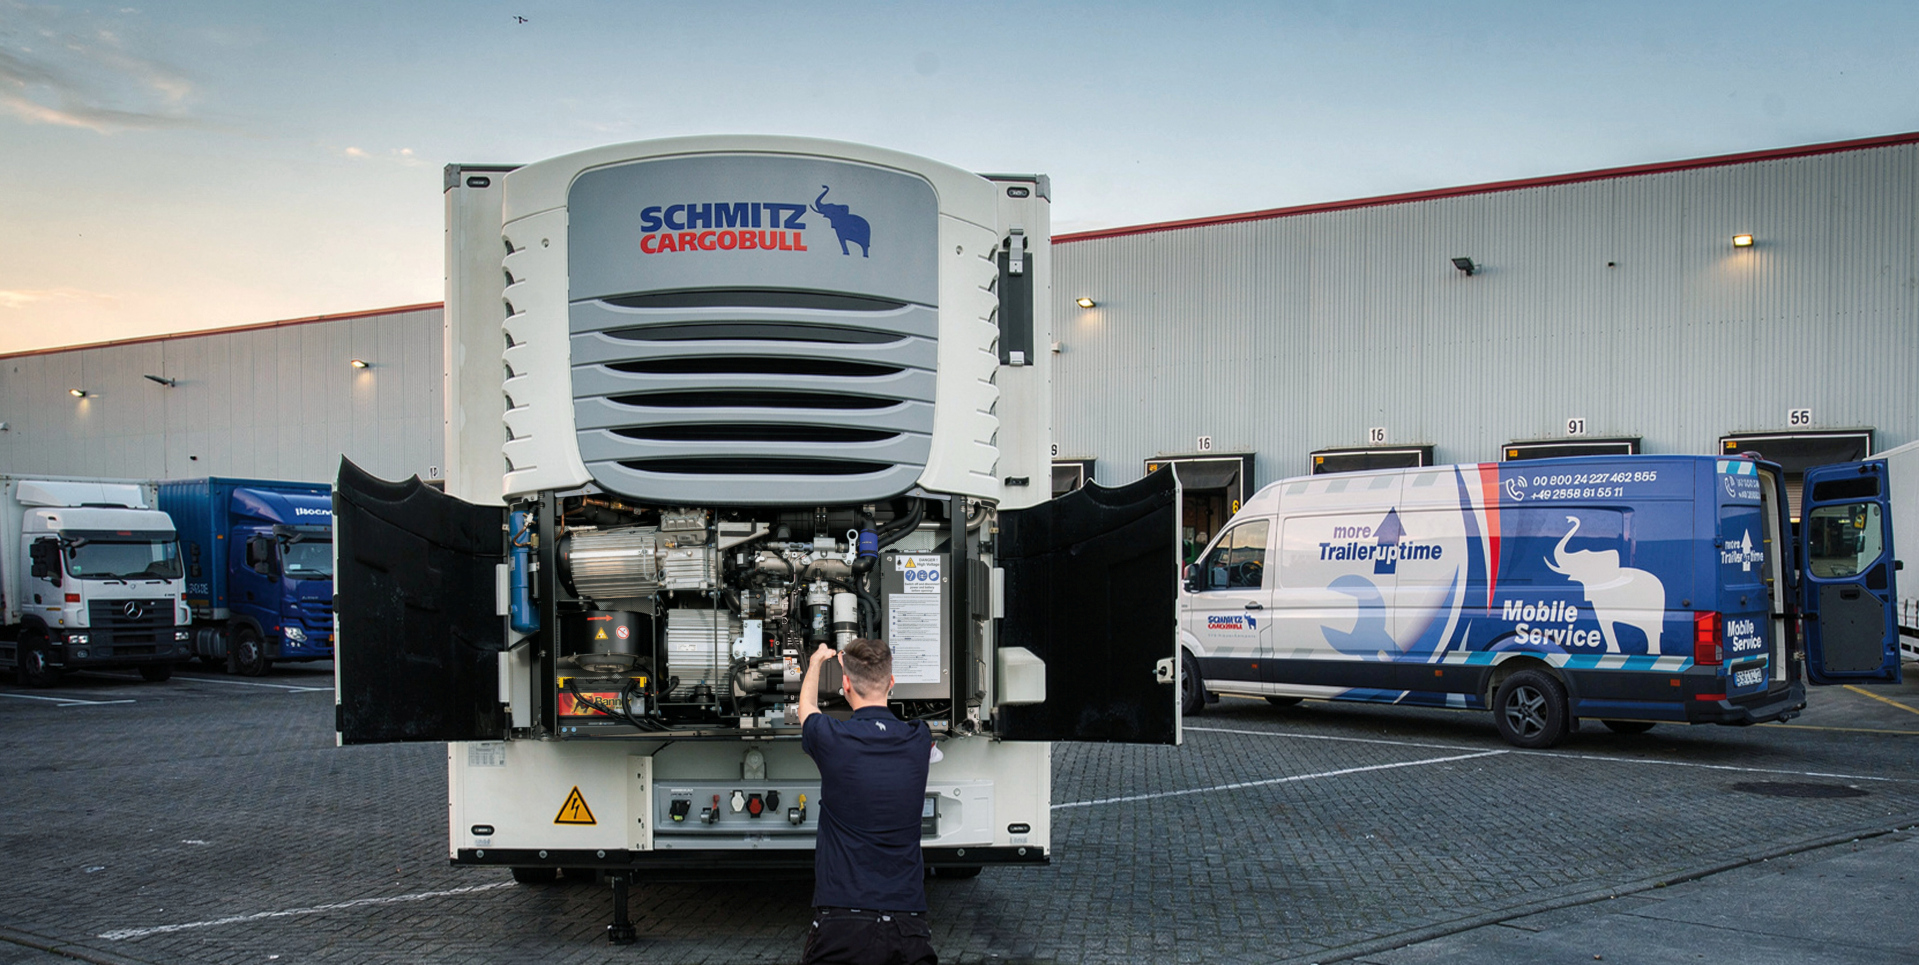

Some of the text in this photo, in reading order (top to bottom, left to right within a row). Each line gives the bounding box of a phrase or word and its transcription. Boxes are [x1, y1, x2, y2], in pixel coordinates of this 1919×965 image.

[640, 202, 807, 232] SCHMITZ
[640, 230, 808, 254] CARGOBULL
[1791, 410, 1809, 425] 56
[1568, 419, 1583, 434] 91
[1371, 428, 1384, 442] 16
[1199, 437, 1210, 450] 16
[1532, 475, 1548, 486] 00
[1549, 474, 1572, 486] 800
[1573, 473, 1588, 485] 24
[1588, 472, 1610, 484] 227
[1610, 471, 1632, 483] 462
[1333, 526, 1372, 539] more
[1501, 599, 1579, 623] Mobile
[1514, 623, 1601, 648] Service
[1727, 619, 1755, 638] Mobile
[1732, 634, 1762, 652] Service
[595, 696, 632, 706] Bann
